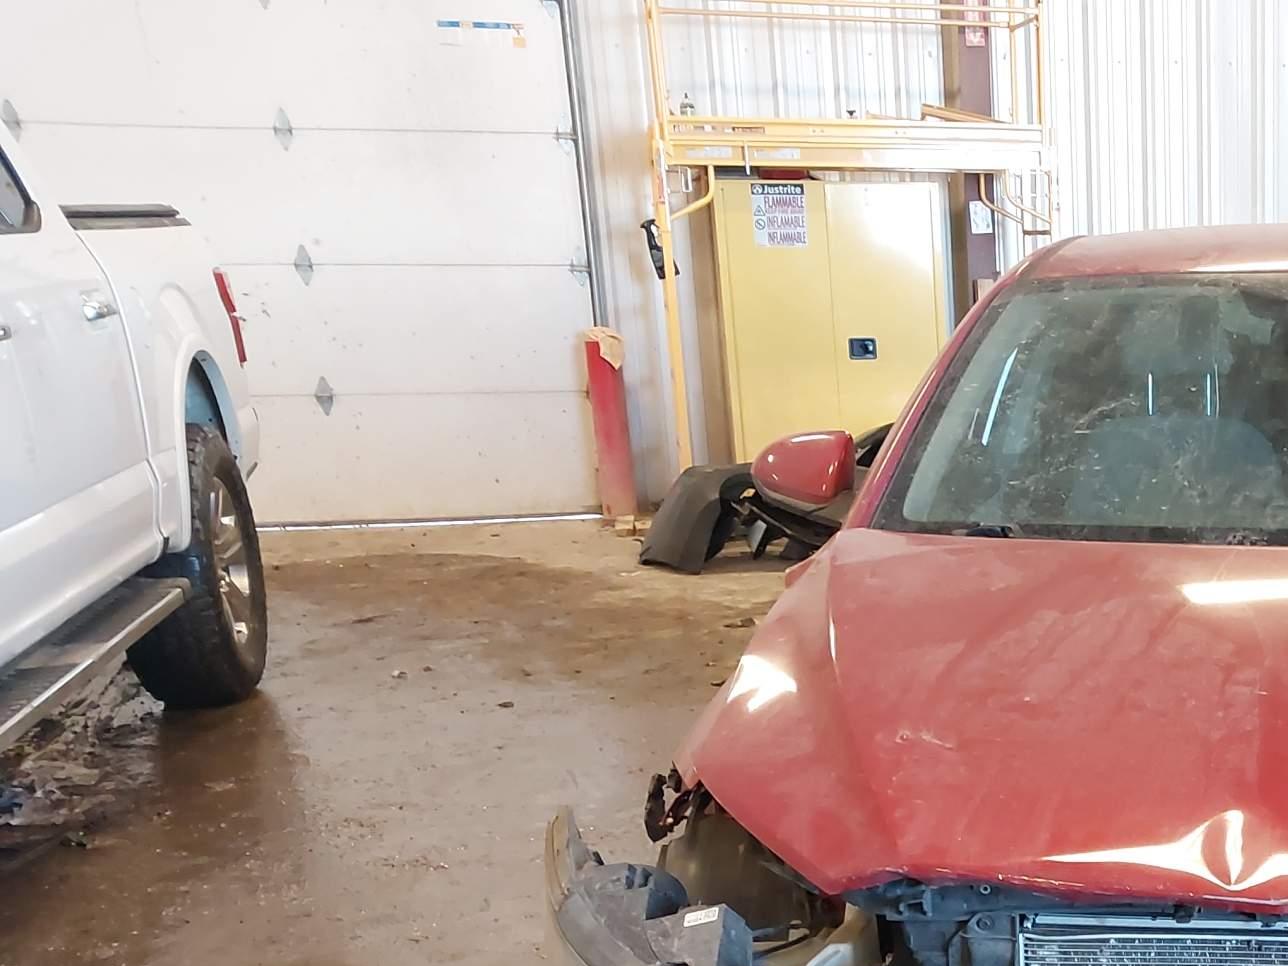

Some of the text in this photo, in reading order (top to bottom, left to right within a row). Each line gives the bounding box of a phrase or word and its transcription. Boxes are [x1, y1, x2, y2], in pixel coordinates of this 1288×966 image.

[764, 185, 801, 194] Justrite
[764, 196, 804, 208] FLAMMABLE
[767, 215, 805, 228] INFLAMABLE
[768, 231, 806, 244] INFLAMMABLE
